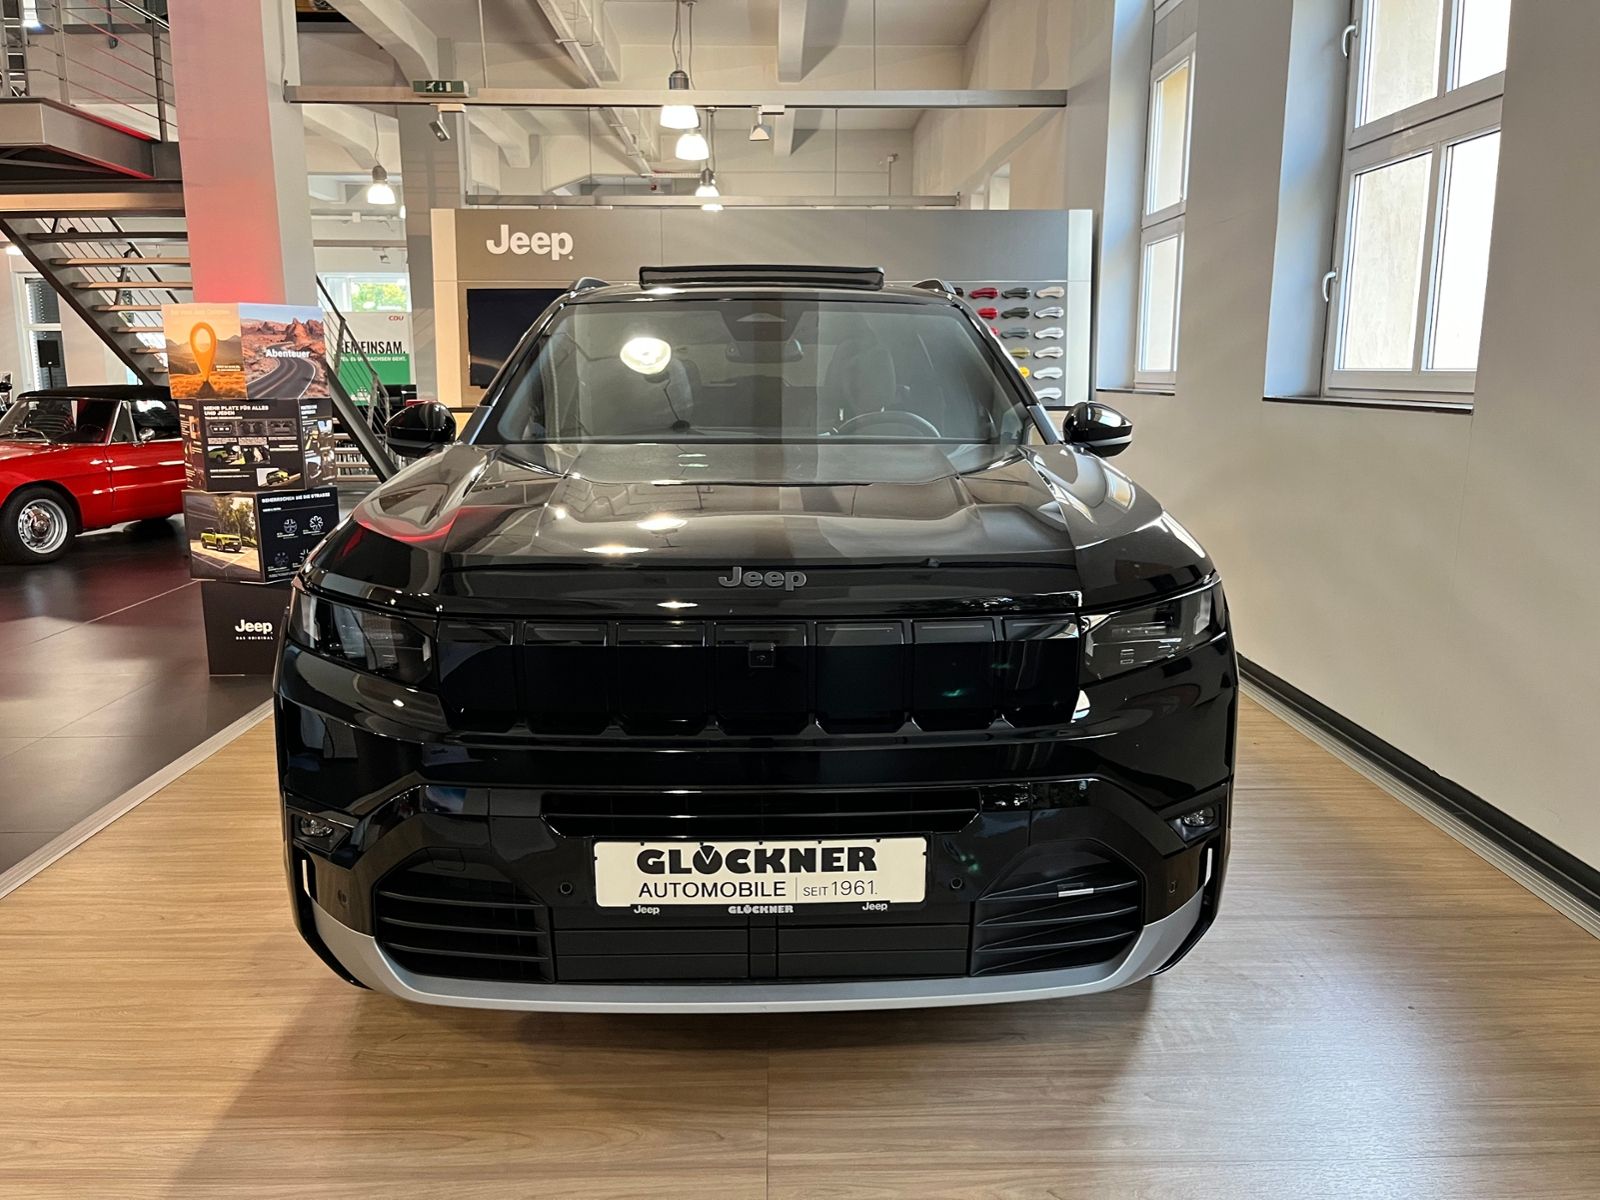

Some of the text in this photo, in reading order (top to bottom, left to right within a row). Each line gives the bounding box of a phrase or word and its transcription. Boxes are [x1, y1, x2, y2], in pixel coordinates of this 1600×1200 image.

[265, 349, 310, 358] Abenteuer
[341, 341, 406, 354] EMEINSAM.
[718, 566, 807, 591] Jeep
[234, 619, 273, 635] Jeep
[638, 880, 878, 898] AUTOMOBILE SEIT 1961.
[633, 905, 660, 915] Jeep
[862, 902, 888, 912] Jeep
